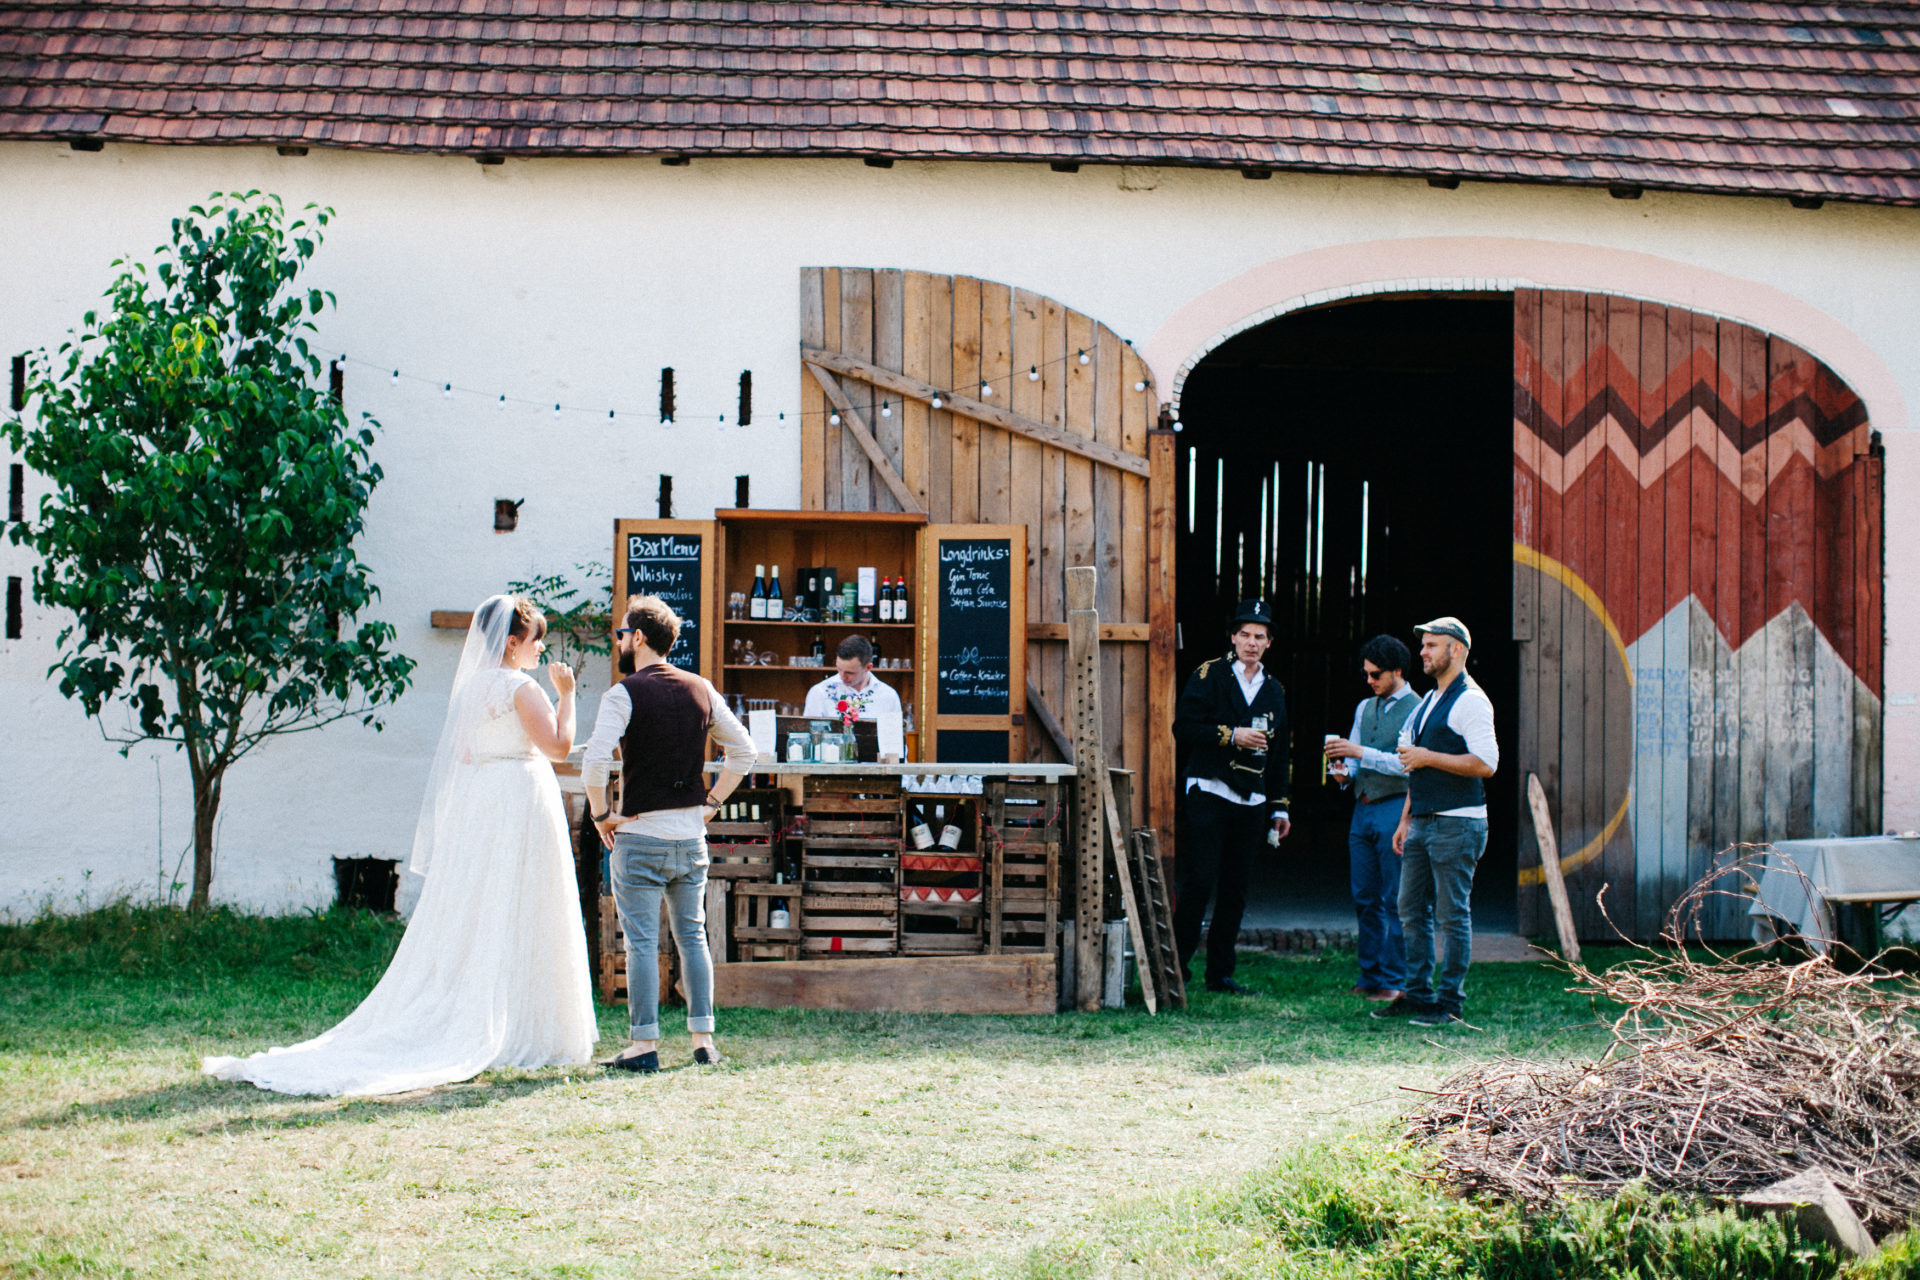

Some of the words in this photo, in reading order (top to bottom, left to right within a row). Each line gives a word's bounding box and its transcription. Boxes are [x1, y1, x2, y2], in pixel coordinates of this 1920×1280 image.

[941, 545, 1010, 568] Longdrinks:
[631, 564, 683, 586] Whisky:
[949, 568, 966, 581] Gin
[966, 567, 990, 581] Tonic
